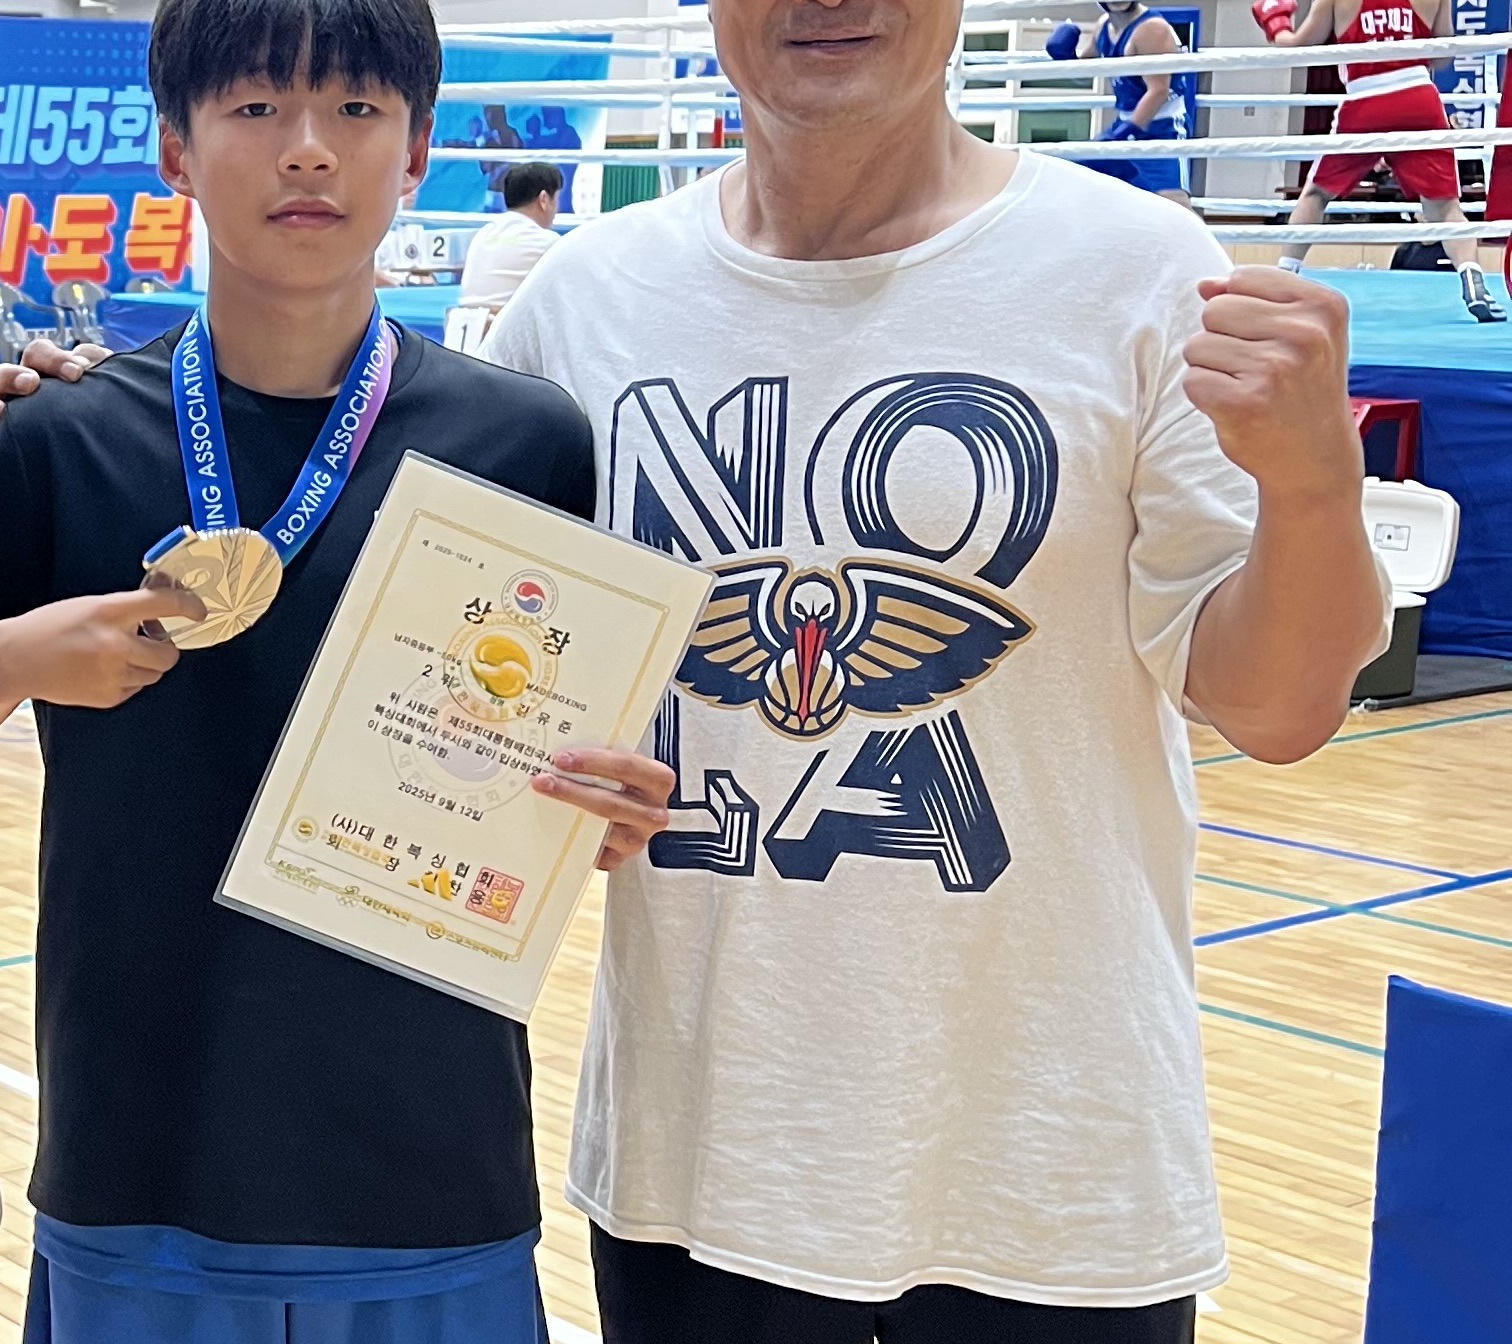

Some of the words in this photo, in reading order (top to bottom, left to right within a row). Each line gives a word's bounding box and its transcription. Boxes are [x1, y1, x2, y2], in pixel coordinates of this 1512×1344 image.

[122, 192, 192, 284] 복
[432, 235, 445, 257] 2
[182, 339, 218, 479] ASSOCIATION
[276, 469, 333, 546] BOXING
[323, 334, 388, 471] ASSOCIATION
[200, 484, 227, 532] ING
[464, 597, 491, 623] 상
[542, 628, 569, 655] 장
[423, 664, 432, 676] 2
[367, 720, 377, 729] 이
[380, 725, 413, 744] 상장을
[498, 754, 546, 778] 입상하였
[397, 782, 435, 802] 2025년
